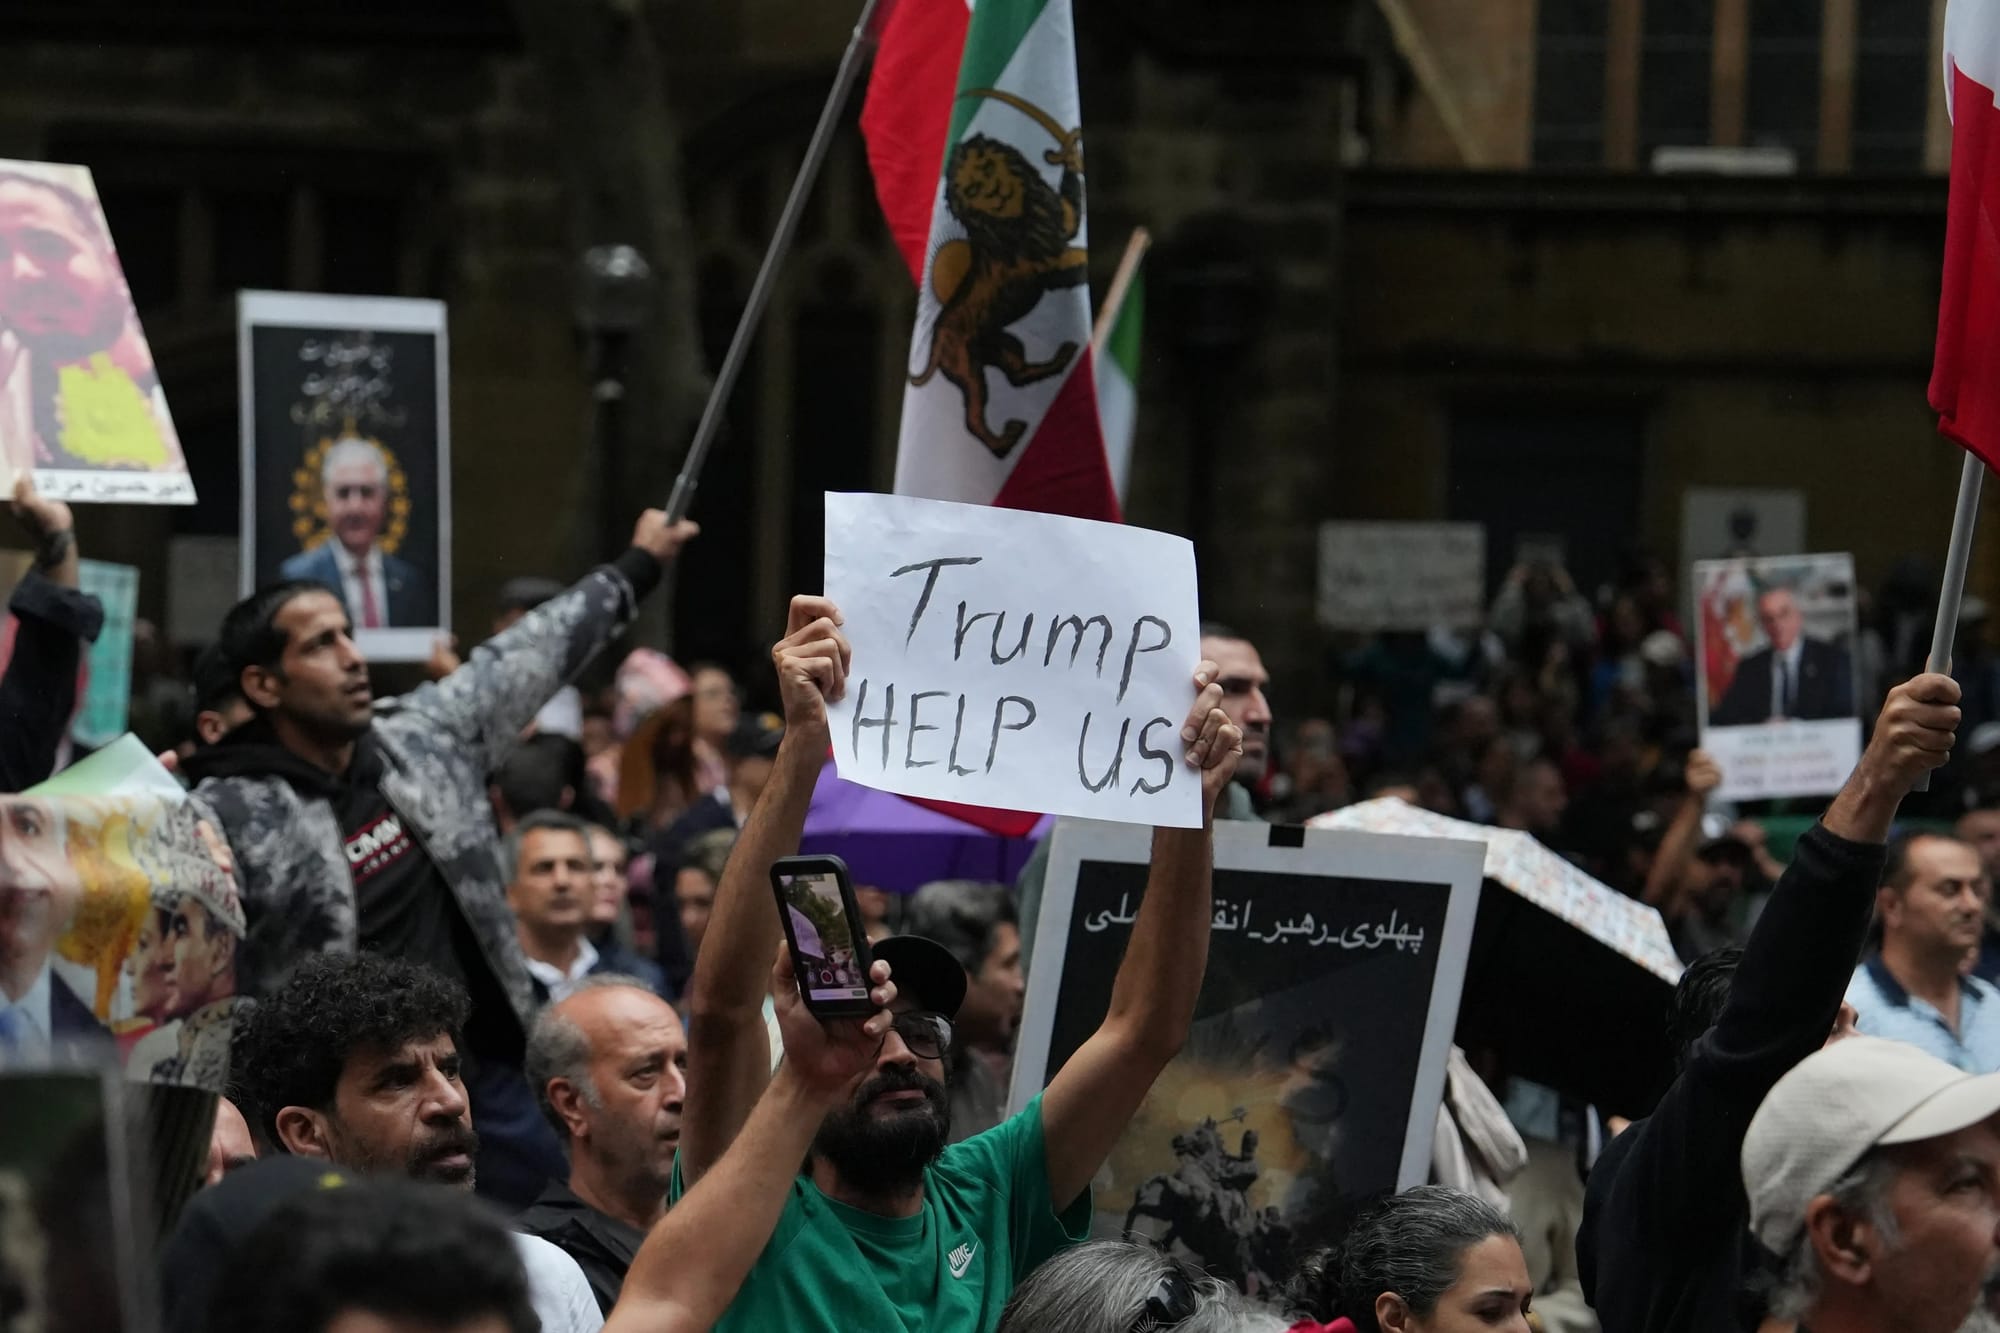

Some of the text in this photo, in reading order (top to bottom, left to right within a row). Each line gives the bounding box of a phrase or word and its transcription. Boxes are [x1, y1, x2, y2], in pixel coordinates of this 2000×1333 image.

[889, 557, 1172, 706] Trump
[852, 678, 1174, 798] HELP US
[948, 1242, 972, 1269] NIKE
